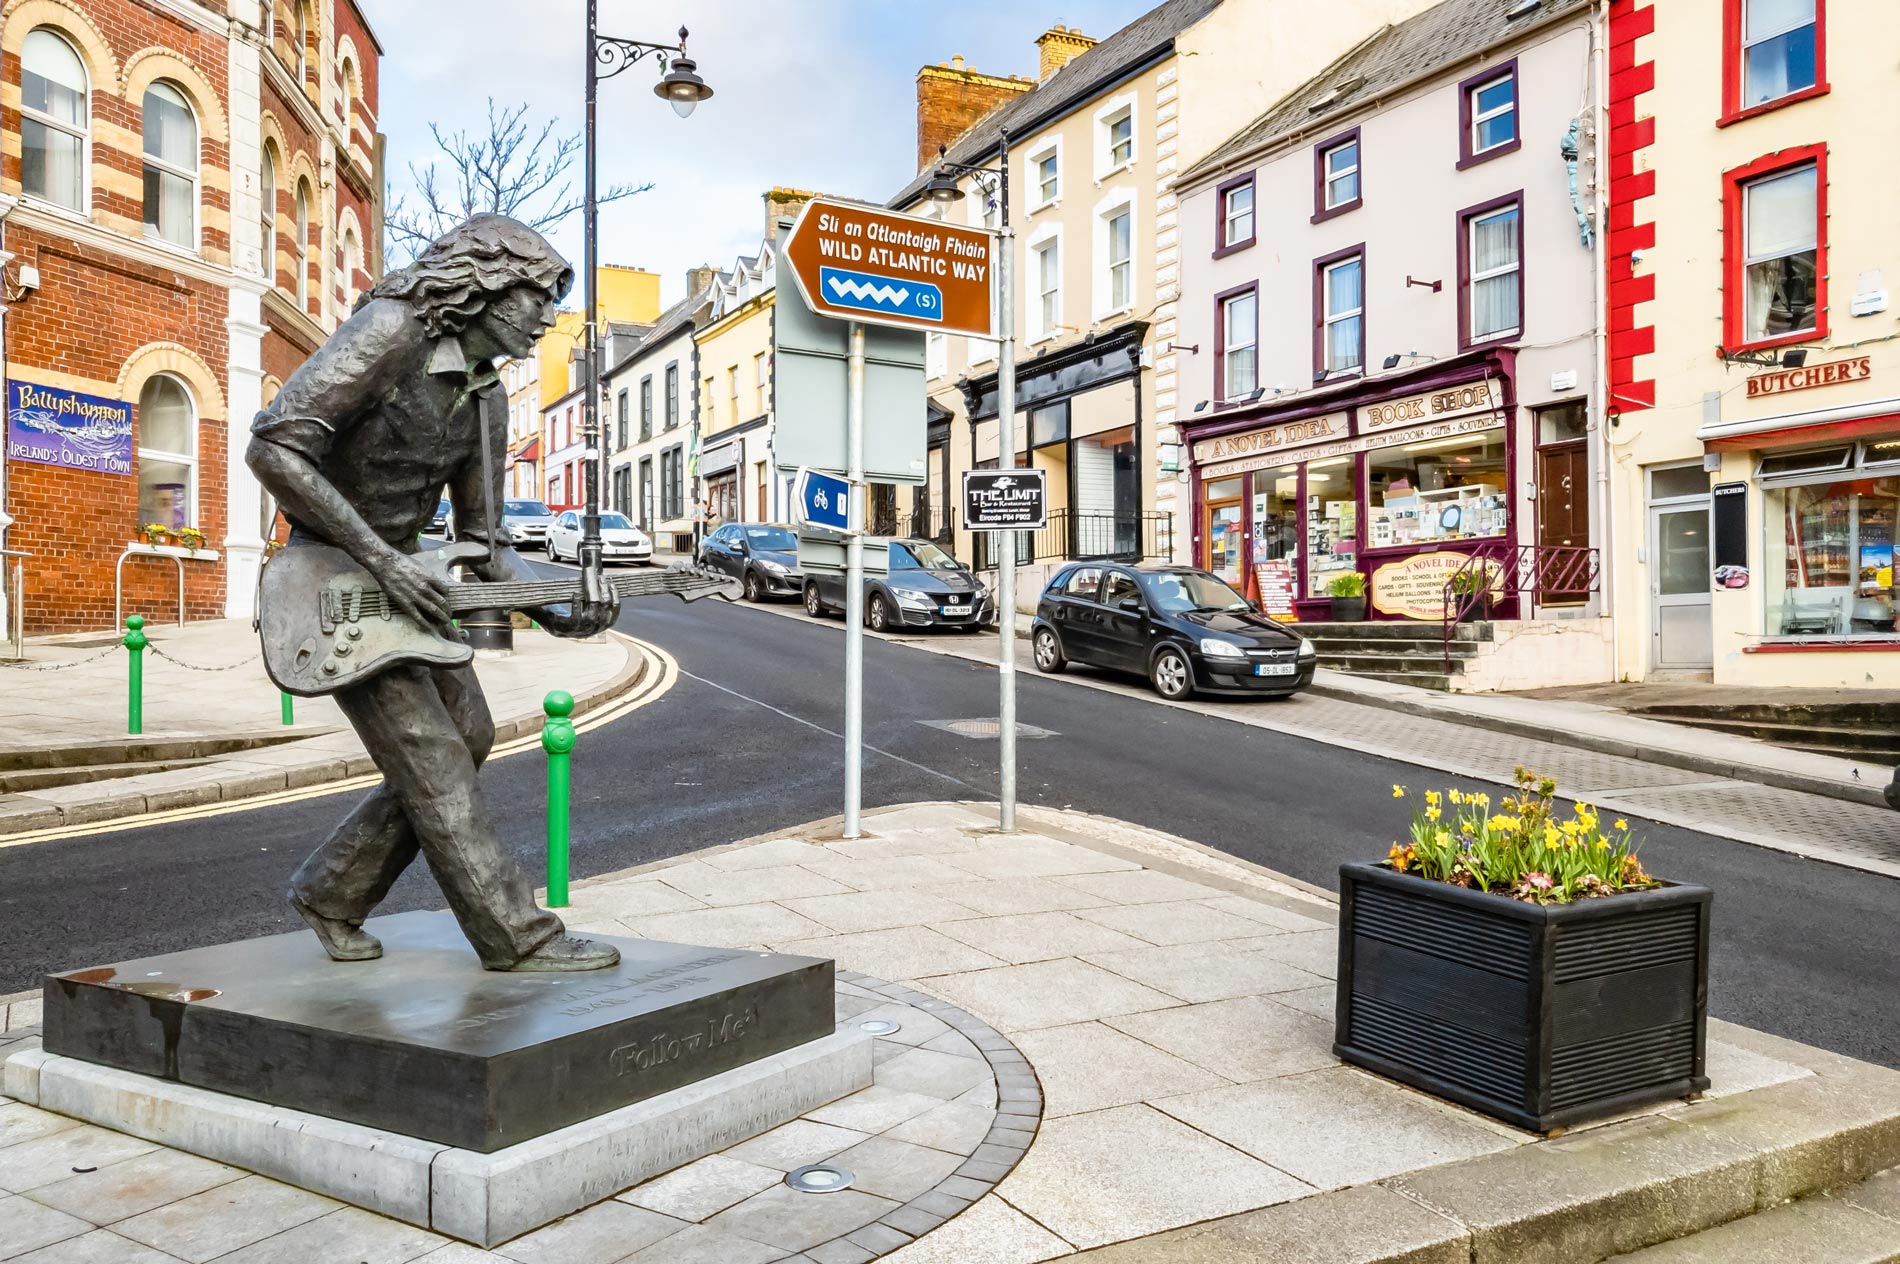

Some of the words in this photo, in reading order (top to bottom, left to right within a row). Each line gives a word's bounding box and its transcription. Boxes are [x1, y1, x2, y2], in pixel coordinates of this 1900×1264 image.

[818, 213, 839, 234] Slí
[844, 223, 862, 238] an
[866, 222, 941, 253] Atlantaigh
[945, 237, 986, 260] Fhiáin
[818, 238, 862, 262] WILD
[868, 247, 947, 276] ATLANTIC
[952, 261, 986, 283] WAY
[915, 292, 937, 310] (S)
[1746, 358, 1871, 396] BUTCHER'S
[17, 385, 126, 422] Ballyshannon
[1367, 397, 1426, 428] BOOK
[1431, 385, 1489, 414] SHOP
[1211, 440, 1226, 459] A
[1226, 429, 1282, 456] NOVEL
[1284, 418, 1335, 444] IDEA
[1388, 430, 1425, 445] BALLOONS
[1430, 426, 1452, 437] GIFTS
[1457, 416, 1498, 432] SOUVENIRS
[10, 441, 58, 462] IRELAND'S
[62, 449, 99, 468] OLDEST
[101, 455, 130, 473] TOWN
[1208, 465, 1235, 477] BOOKS
[1241, 455, 1286, 472] STATIONERY
[1291, 448, 1322, 463] CARDS
[1328, 443, 1353, 456] GIFTS
[969, 489, 1003, 502] THE
[1003, 488, 1041, 501] LIMIT
[1715, 486, 1745, 496] BUTCHERS
[1405, 566, 1411, 574] A
[1413, 558, 1442, 571] NOVEL
